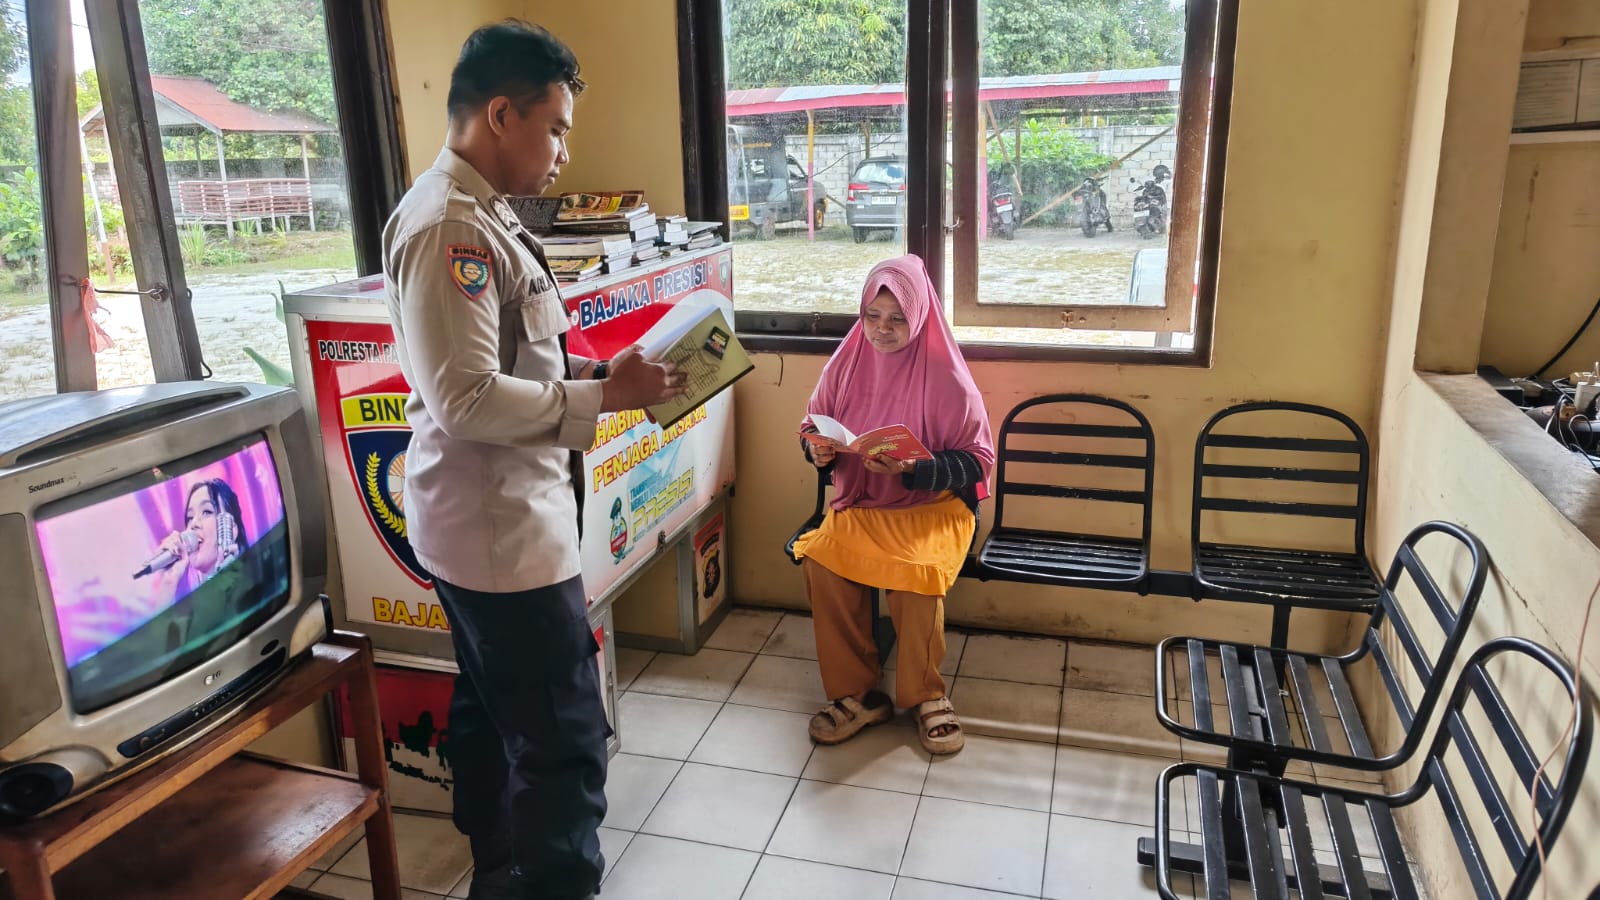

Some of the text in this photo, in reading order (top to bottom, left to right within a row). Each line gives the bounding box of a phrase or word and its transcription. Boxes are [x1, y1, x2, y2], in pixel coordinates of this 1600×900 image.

[580, 260, 708, 330] BAJAKA PRESISI
[319, 340, 380, 362] POLRESTA
[592, 431, 660, 494] PENJAGA
[28, 478, 64, 494] Soundmax
